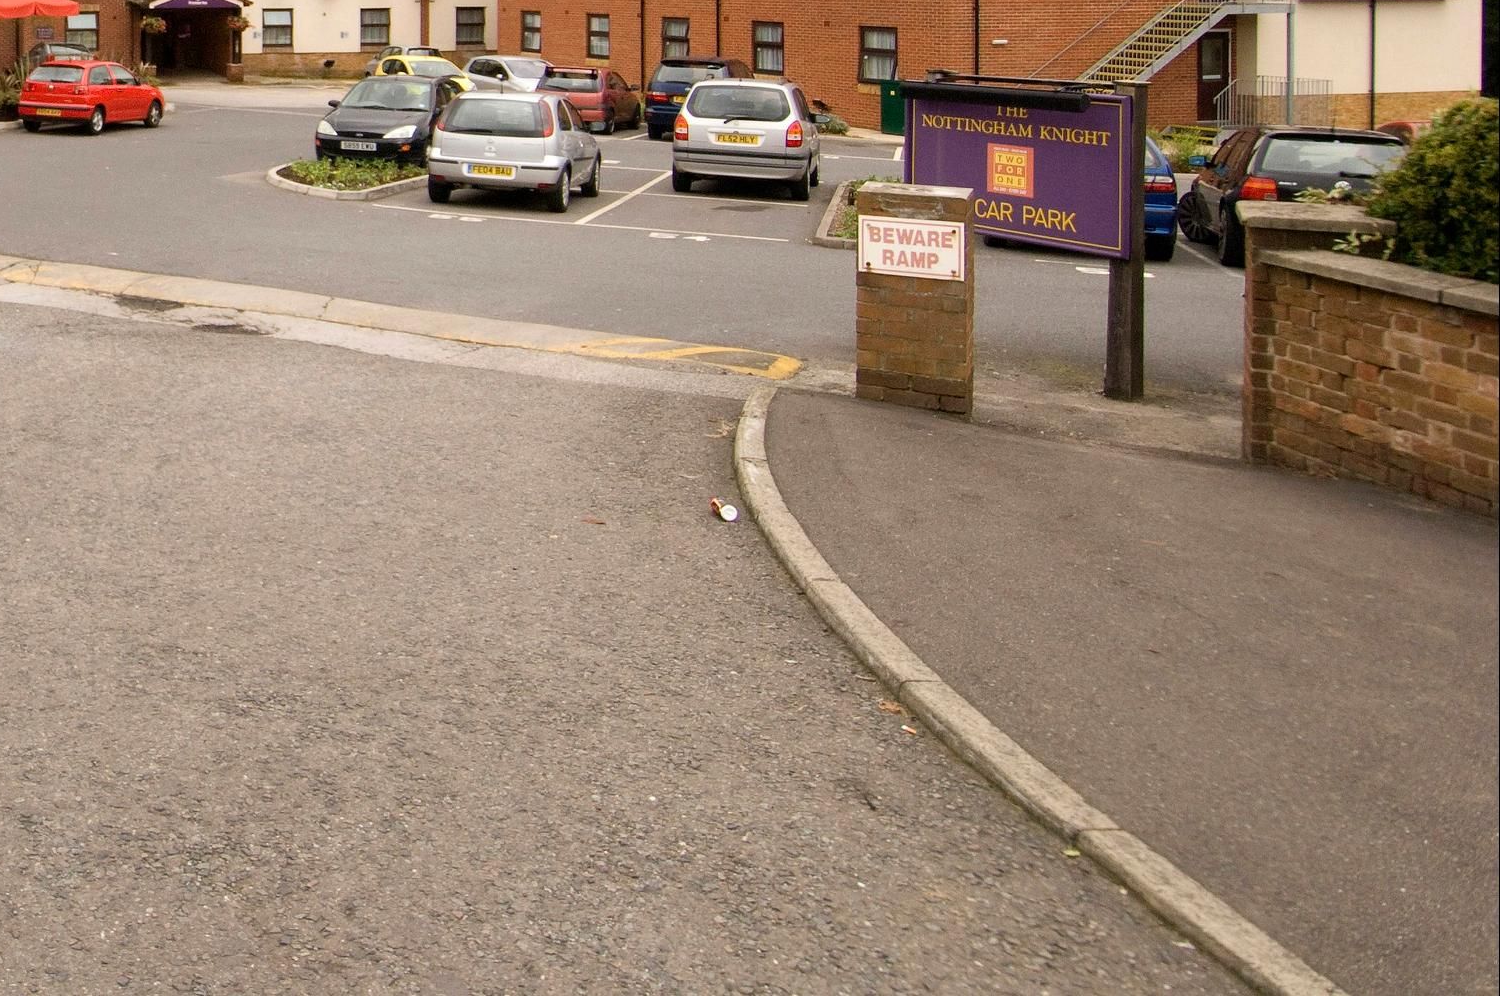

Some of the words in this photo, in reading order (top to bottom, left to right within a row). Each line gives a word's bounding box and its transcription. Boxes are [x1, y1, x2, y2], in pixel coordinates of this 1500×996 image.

[921, 114, 1033, 139] NOTTINGHAM
[1039, 125, 1112, 147] KNIGHT
[996, 153, 1025, 165] TWO
[472, 165, 493, 174] FE04
[996, 164, 1024, 176] FOR
[996, 175, 1024, 187] ONE
[974, 197, 1013, 224] CAR
[1021, 205, 1078, 234] PARK
[868, 226, 954, 249] BEWARE
[881, 249, 940, 269] RAMP
